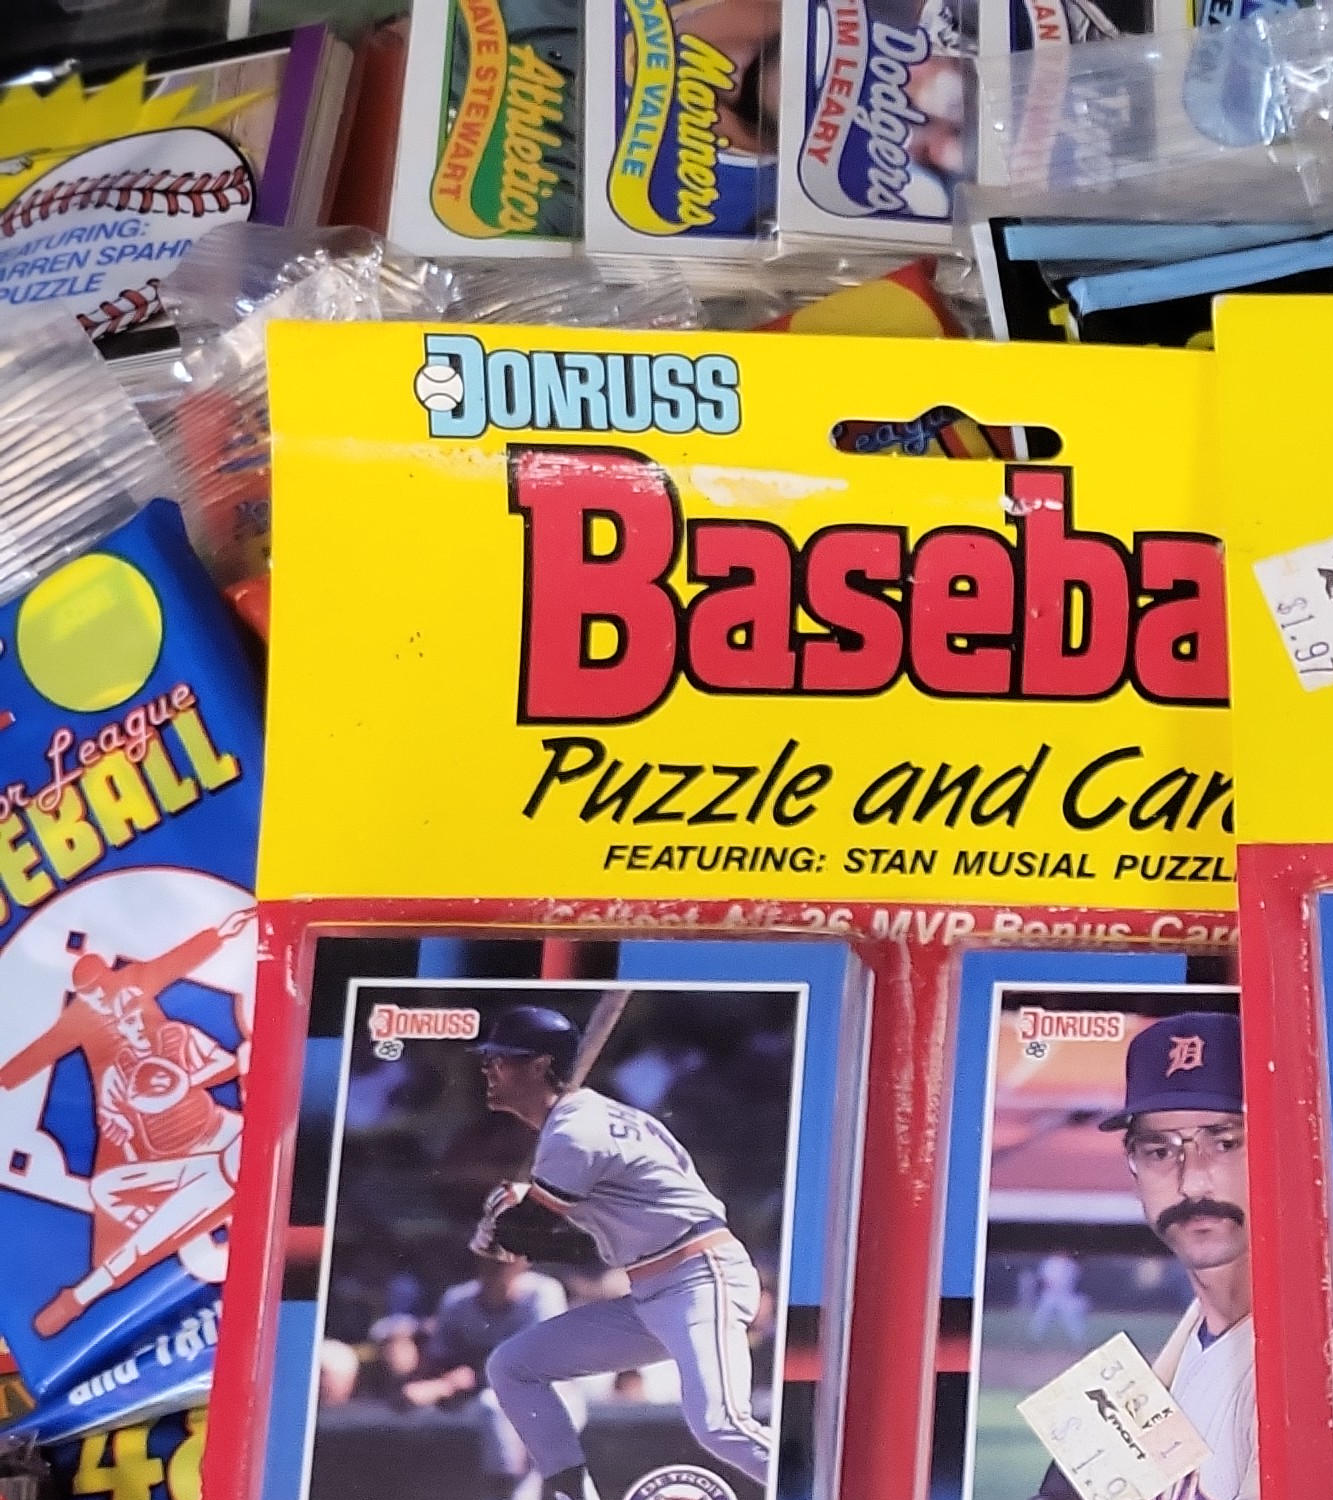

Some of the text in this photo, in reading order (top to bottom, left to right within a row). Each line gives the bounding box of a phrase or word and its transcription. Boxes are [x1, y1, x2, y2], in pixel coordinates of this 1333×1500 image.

[439, 65, 497, 200] STEWART
[499, 42, 566, 234] Athletics
[621, 82, 665, 178] VALLE
[676, 34, 737, 228] Mariners
[804, 58, 857, 165] LEARY
[865, 22, 930, 212] Dodgers
[414, 333, 742, 438] DONRUSS
[36, 682, 197, 813] League
[522, 735, 1053, 832] Puzzle and
[603, 844, 1097, 881] FEATURING: STAN MUSIAL
[872, 909, 976, 946] MVP
[370, 1005, 477, 1040] DONRUSS
[1020, 1009, 1121, 1040] DONRUSS
[1084, 1387, 1147, 1460] Kmart
[638, 1472, 725, 1500] DETROIT
